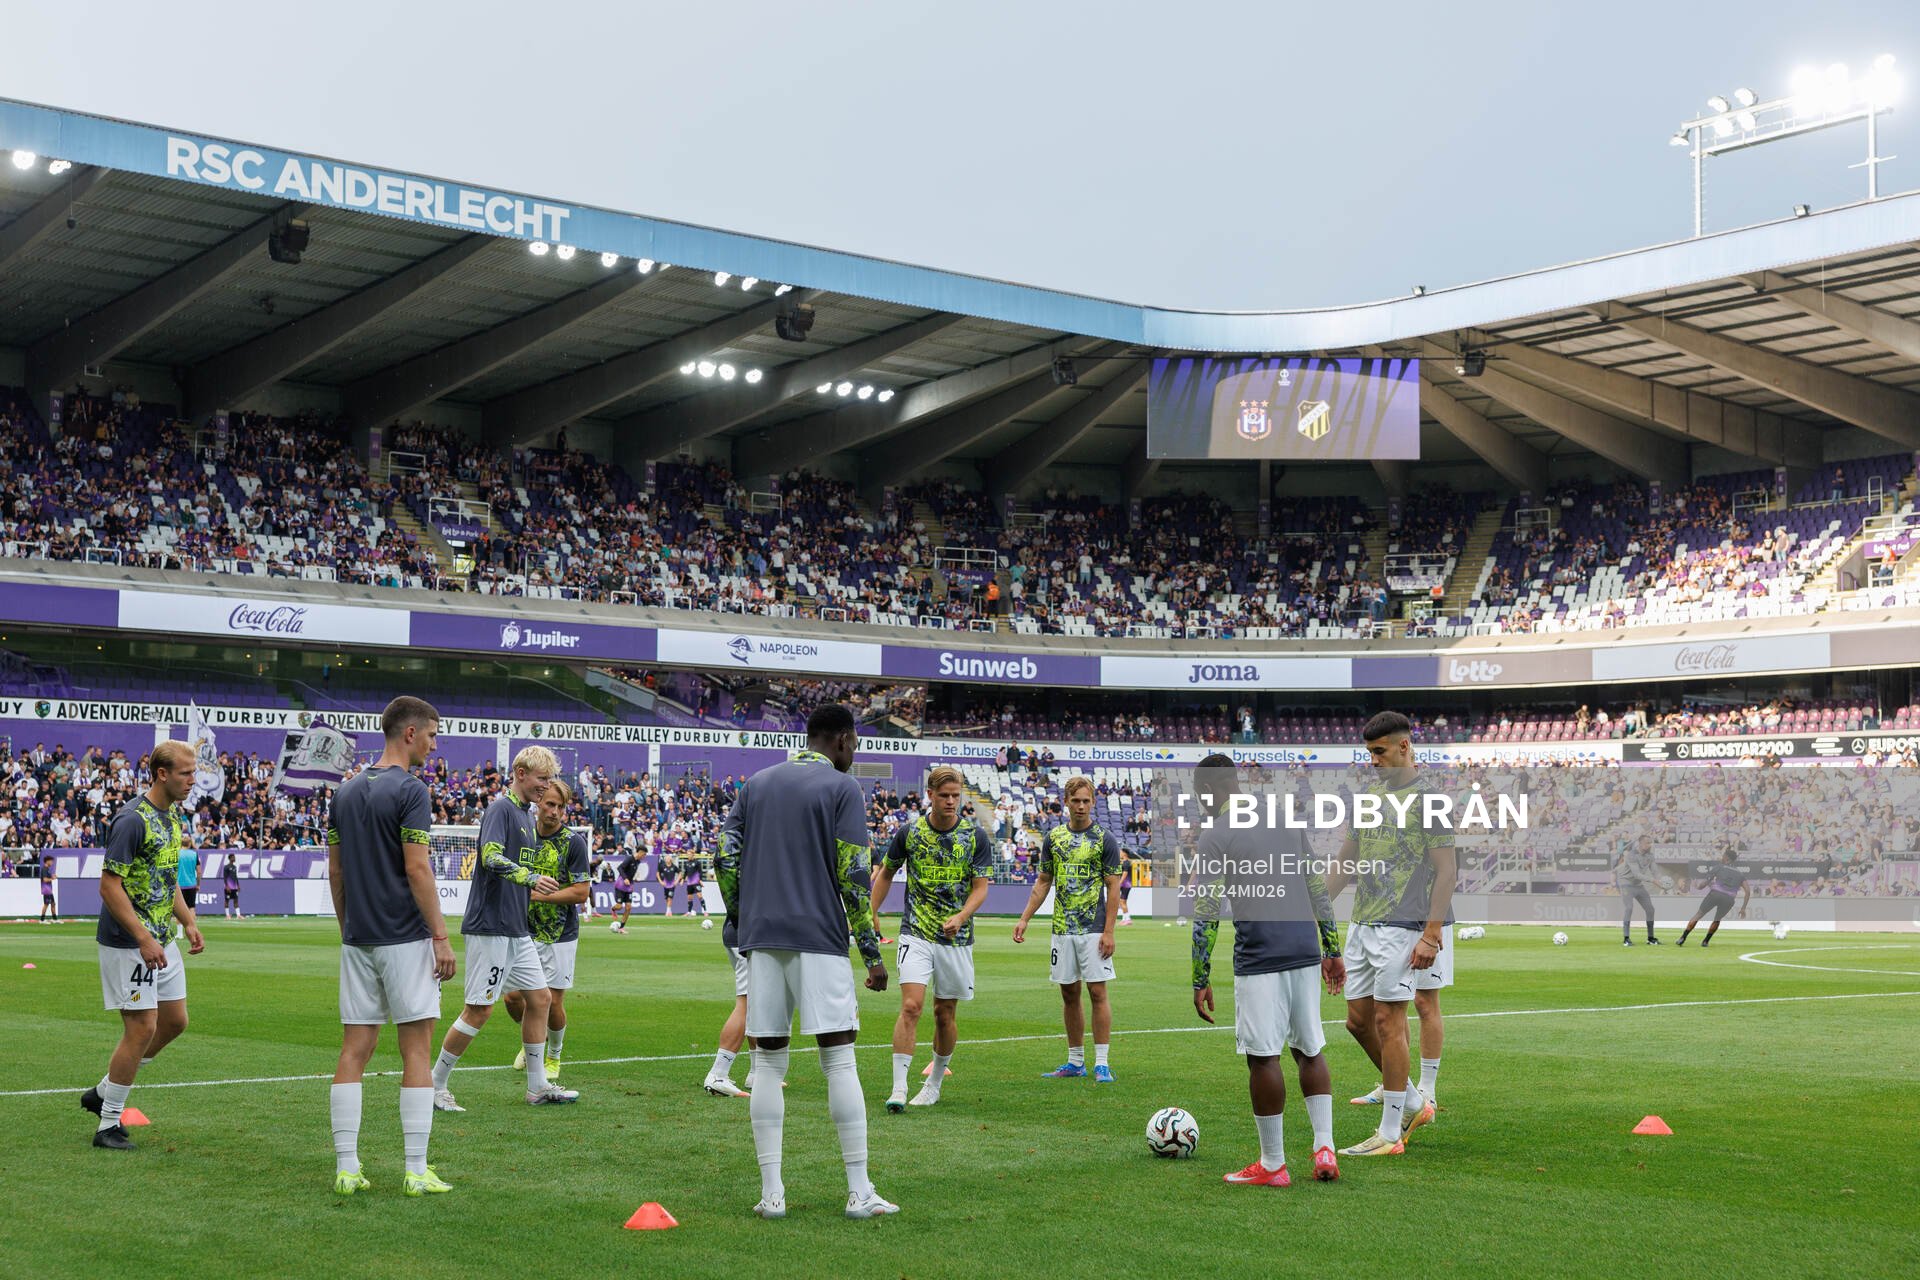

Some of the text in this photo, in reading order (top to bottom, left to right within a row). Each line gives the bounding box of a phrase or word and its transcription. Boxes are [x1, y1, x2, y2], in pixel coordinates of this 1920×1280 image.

[167, 136, 571, 242] RSC ANDERLECHT
[228, 603, 309, 633] Coca-Cola
[521, 628, 580, 649] Jupiler
[759, 642, 818, 657] NAPOLEON
[939, 652, 1038, 679] Sunweb
[1674, 644, 1739, 672] Coca-Cola
[56, 702, 288, 725] ADVENTURE VALLY DURBUY
[458, 721, 522, 736] DURBUY
[547, 722, 731, 745] ADVENTURE VALLEY DURBUY
[866, 739, 918, 752] DURBUY
[1533, 900, 1608, 921] Sunweb
[130, 963, 154, 986] 44
